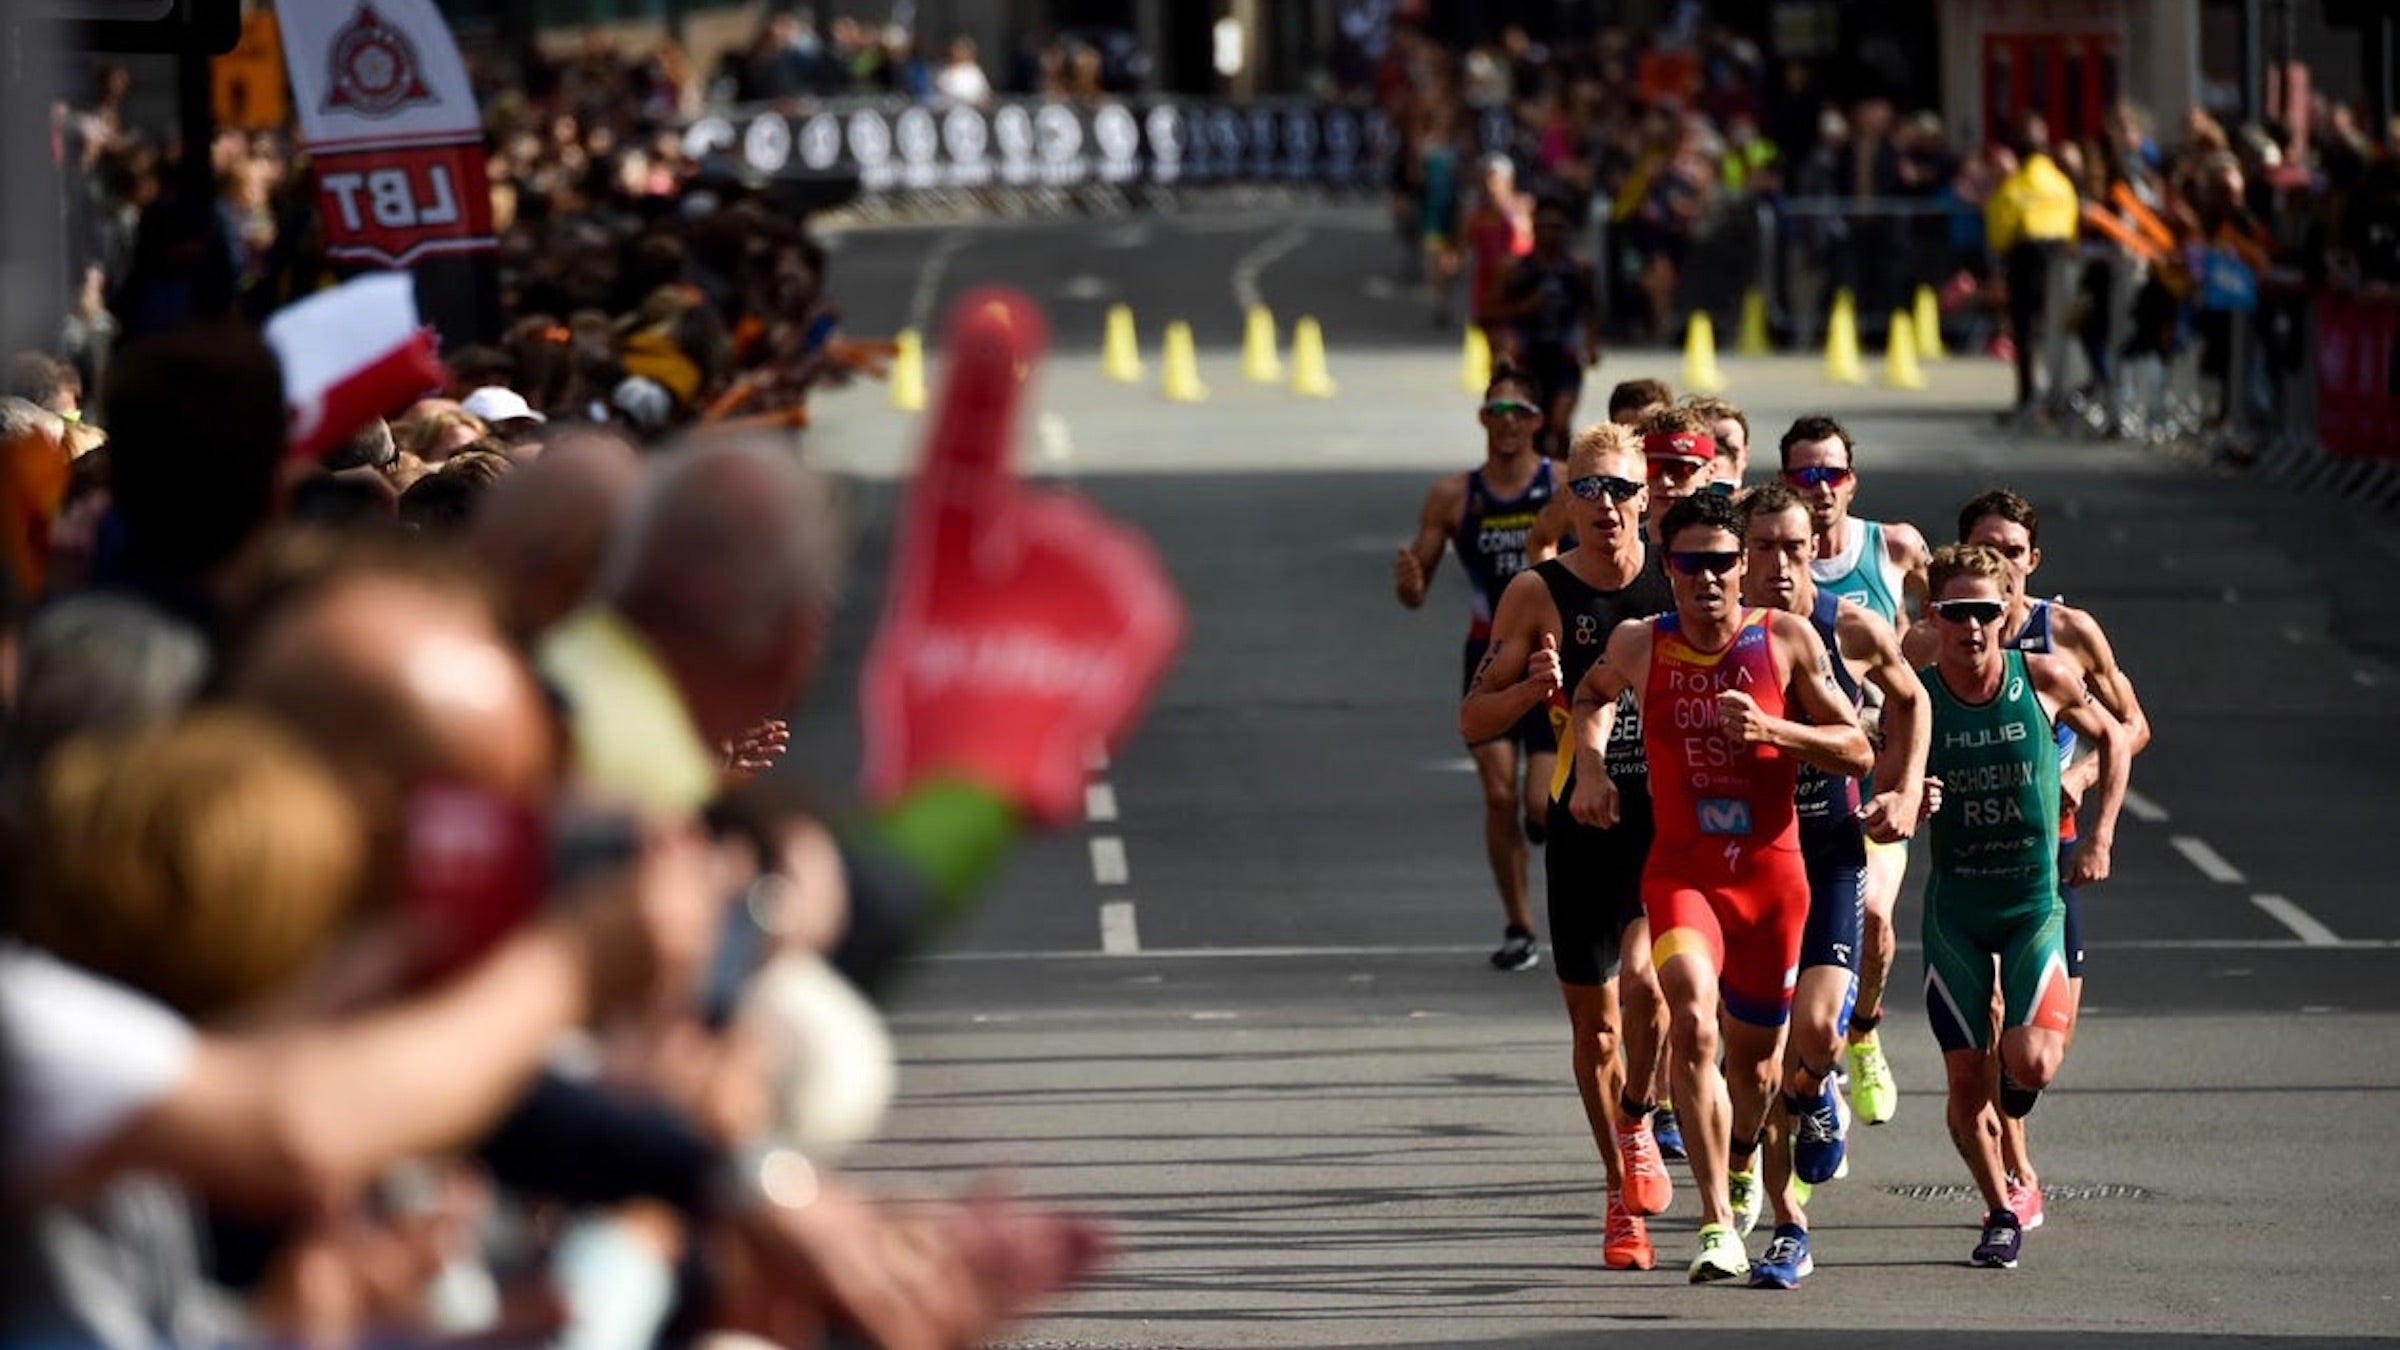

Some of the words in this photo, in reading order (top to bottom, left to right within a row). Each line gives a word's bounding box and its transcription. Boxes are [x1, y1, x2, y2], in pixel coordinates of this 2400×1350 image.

[1674, 697, 1722, 729] GOM
[1611, 761, 1649, 777] SWIS
[1963, 796, 2024, 827] RSA
